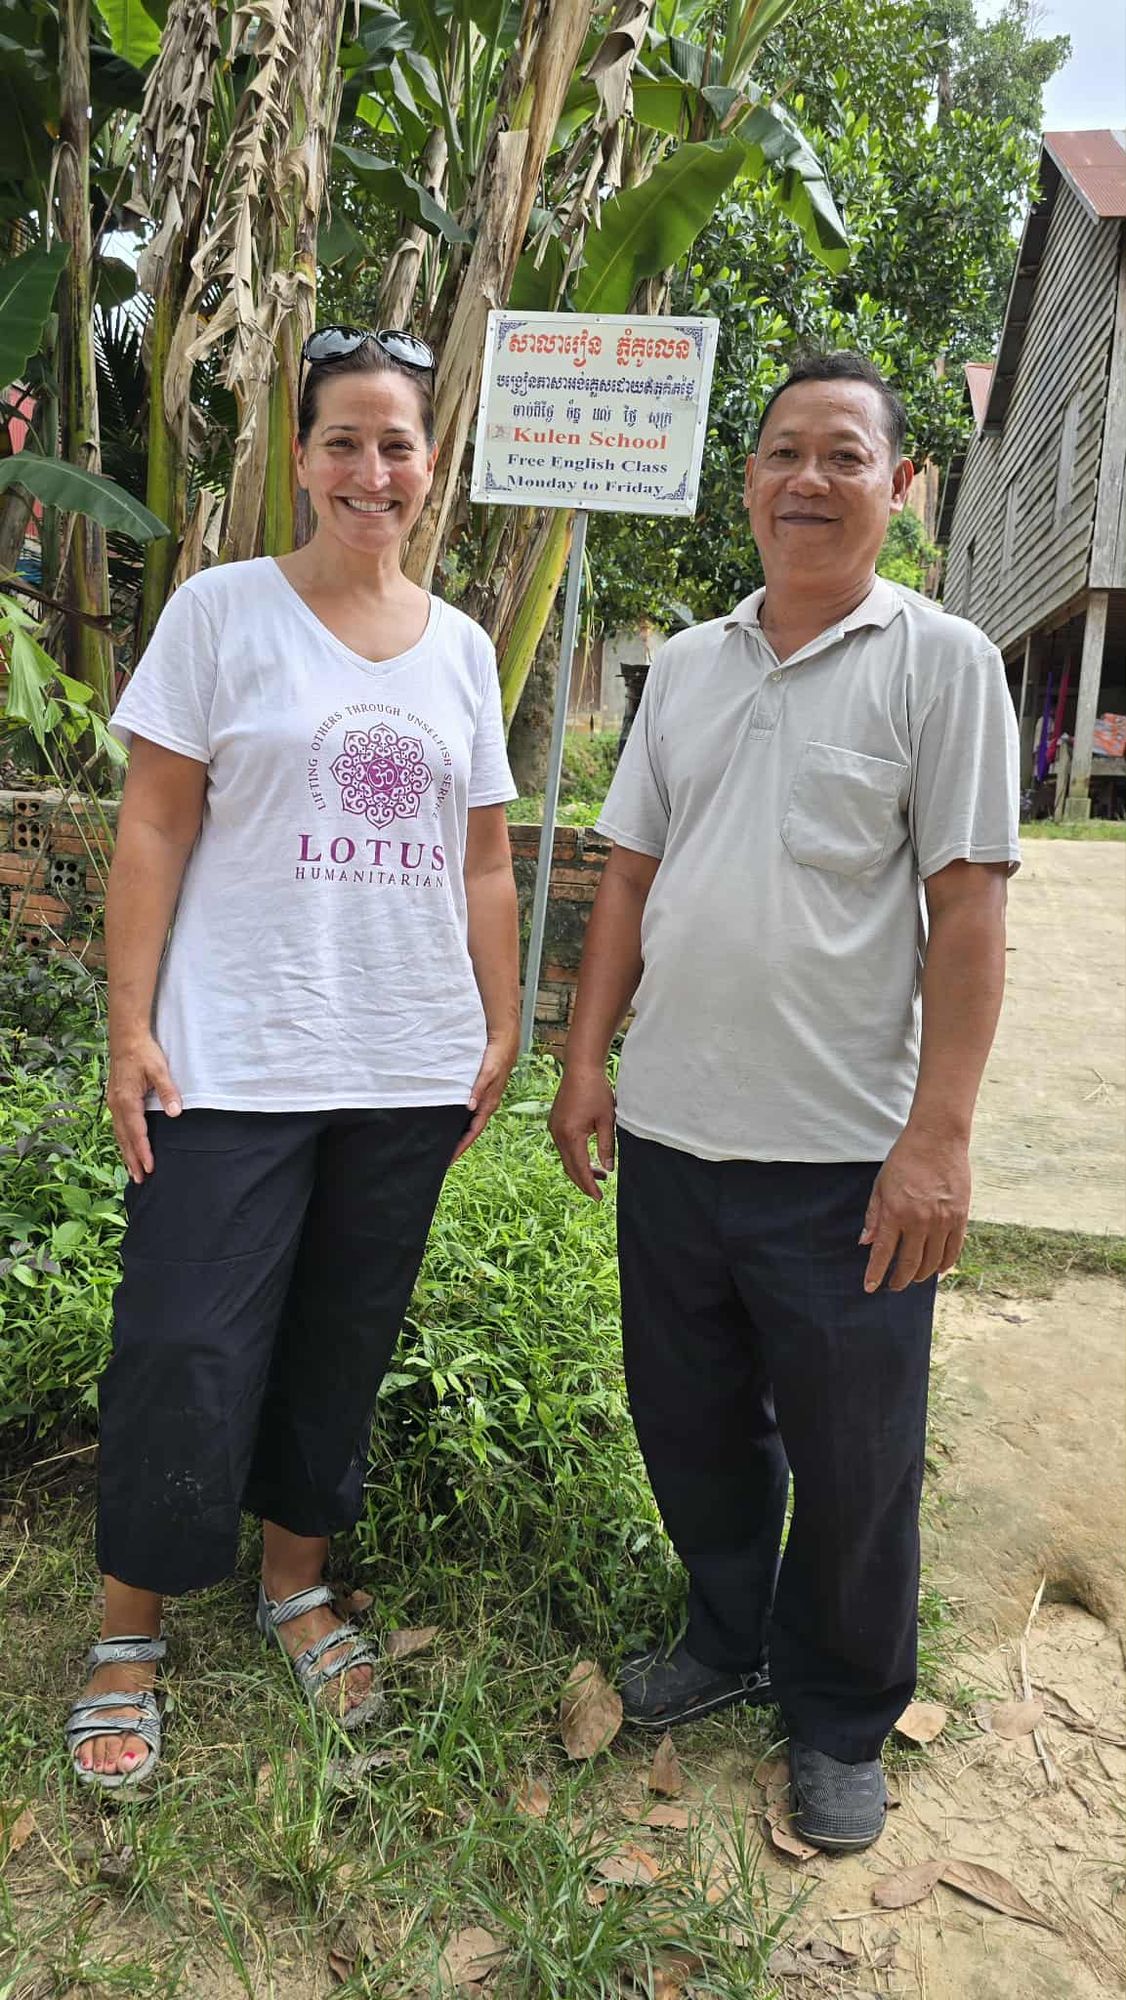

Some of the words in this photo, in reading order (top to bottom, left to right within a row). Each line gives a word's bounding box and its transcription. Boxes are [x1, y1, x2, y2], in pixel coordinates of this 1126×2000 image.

[508, 329, 602, 368] សាលារៀន
[513, 427, 580, 445] Kulen
[589, 431, 668, 450] School
[507, 453, 545, 468] Free
[551, 456, 615, 472] English
[621, 460, 668, 473] Class
[507, 475, 577, 493] Monday
[583, 480, 599, 491] to
[605, 481, 664, 498] Friday
[344, 703, 401, 717] THROUGH
[311, 711, 343, 751] OTHERS
[407, 713, 452, 766] UNSELFISH
[308, 758, 326, 810] LIFTING
[297, 834, 445, 871] LOTUS
[295, 866, 444, 888] HUMANITARIAN
